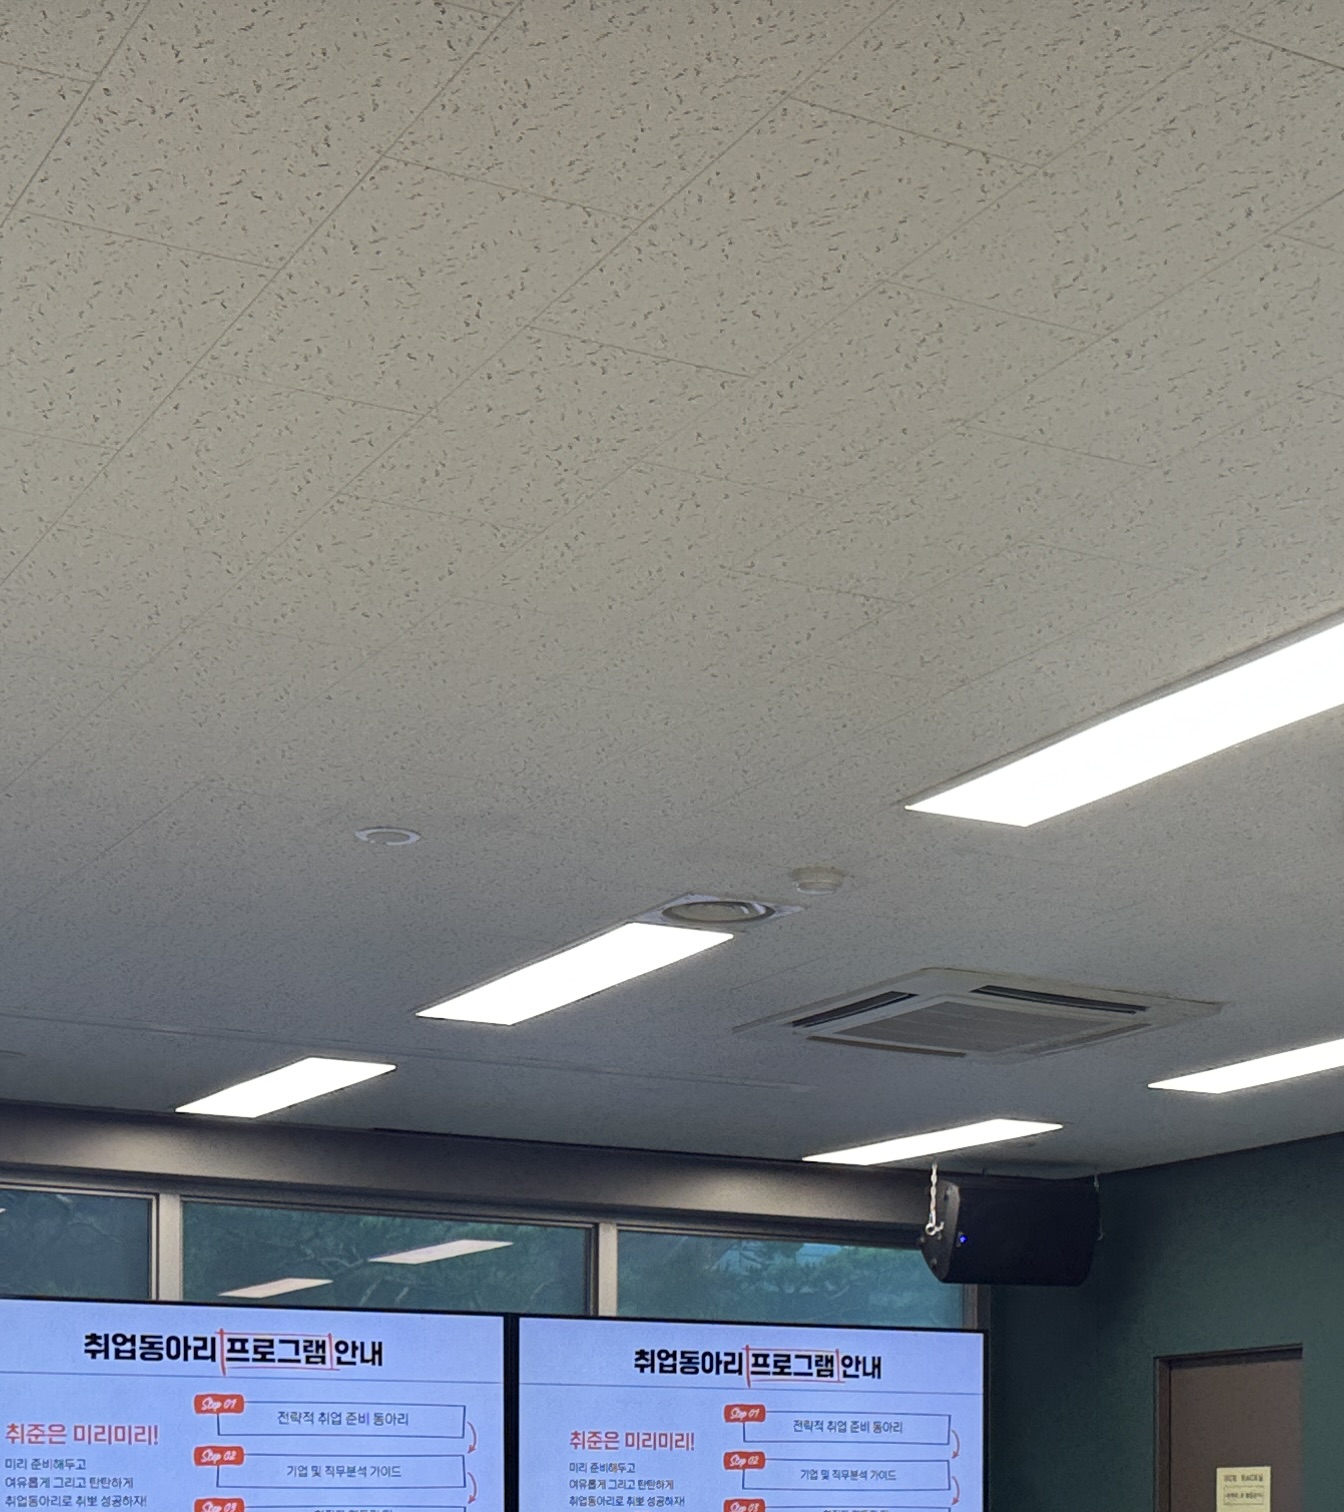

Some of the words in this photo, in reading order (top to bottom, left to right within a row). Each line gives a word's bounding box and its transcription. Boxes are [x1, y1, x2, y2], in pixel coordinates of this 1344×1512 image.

[83, 1332, 217, 1363] 취업동아리
[225, 1337, 327, 1365] 프로그램
[334, 1339, 383, 1367] 안내
[634, 1348, 743, 1376] 취업동아리
[750, 1352, 835, 1378] 프로그램
[840, 1354, 882, 1380] 안내
[5, 1423, 68, 1445] 취준은
[73, 1424, 159, 1446] 미리미리!
[569, 1430, 620, 1451] 취준은
[624, 1431, 695, 1452] 미리미리!
